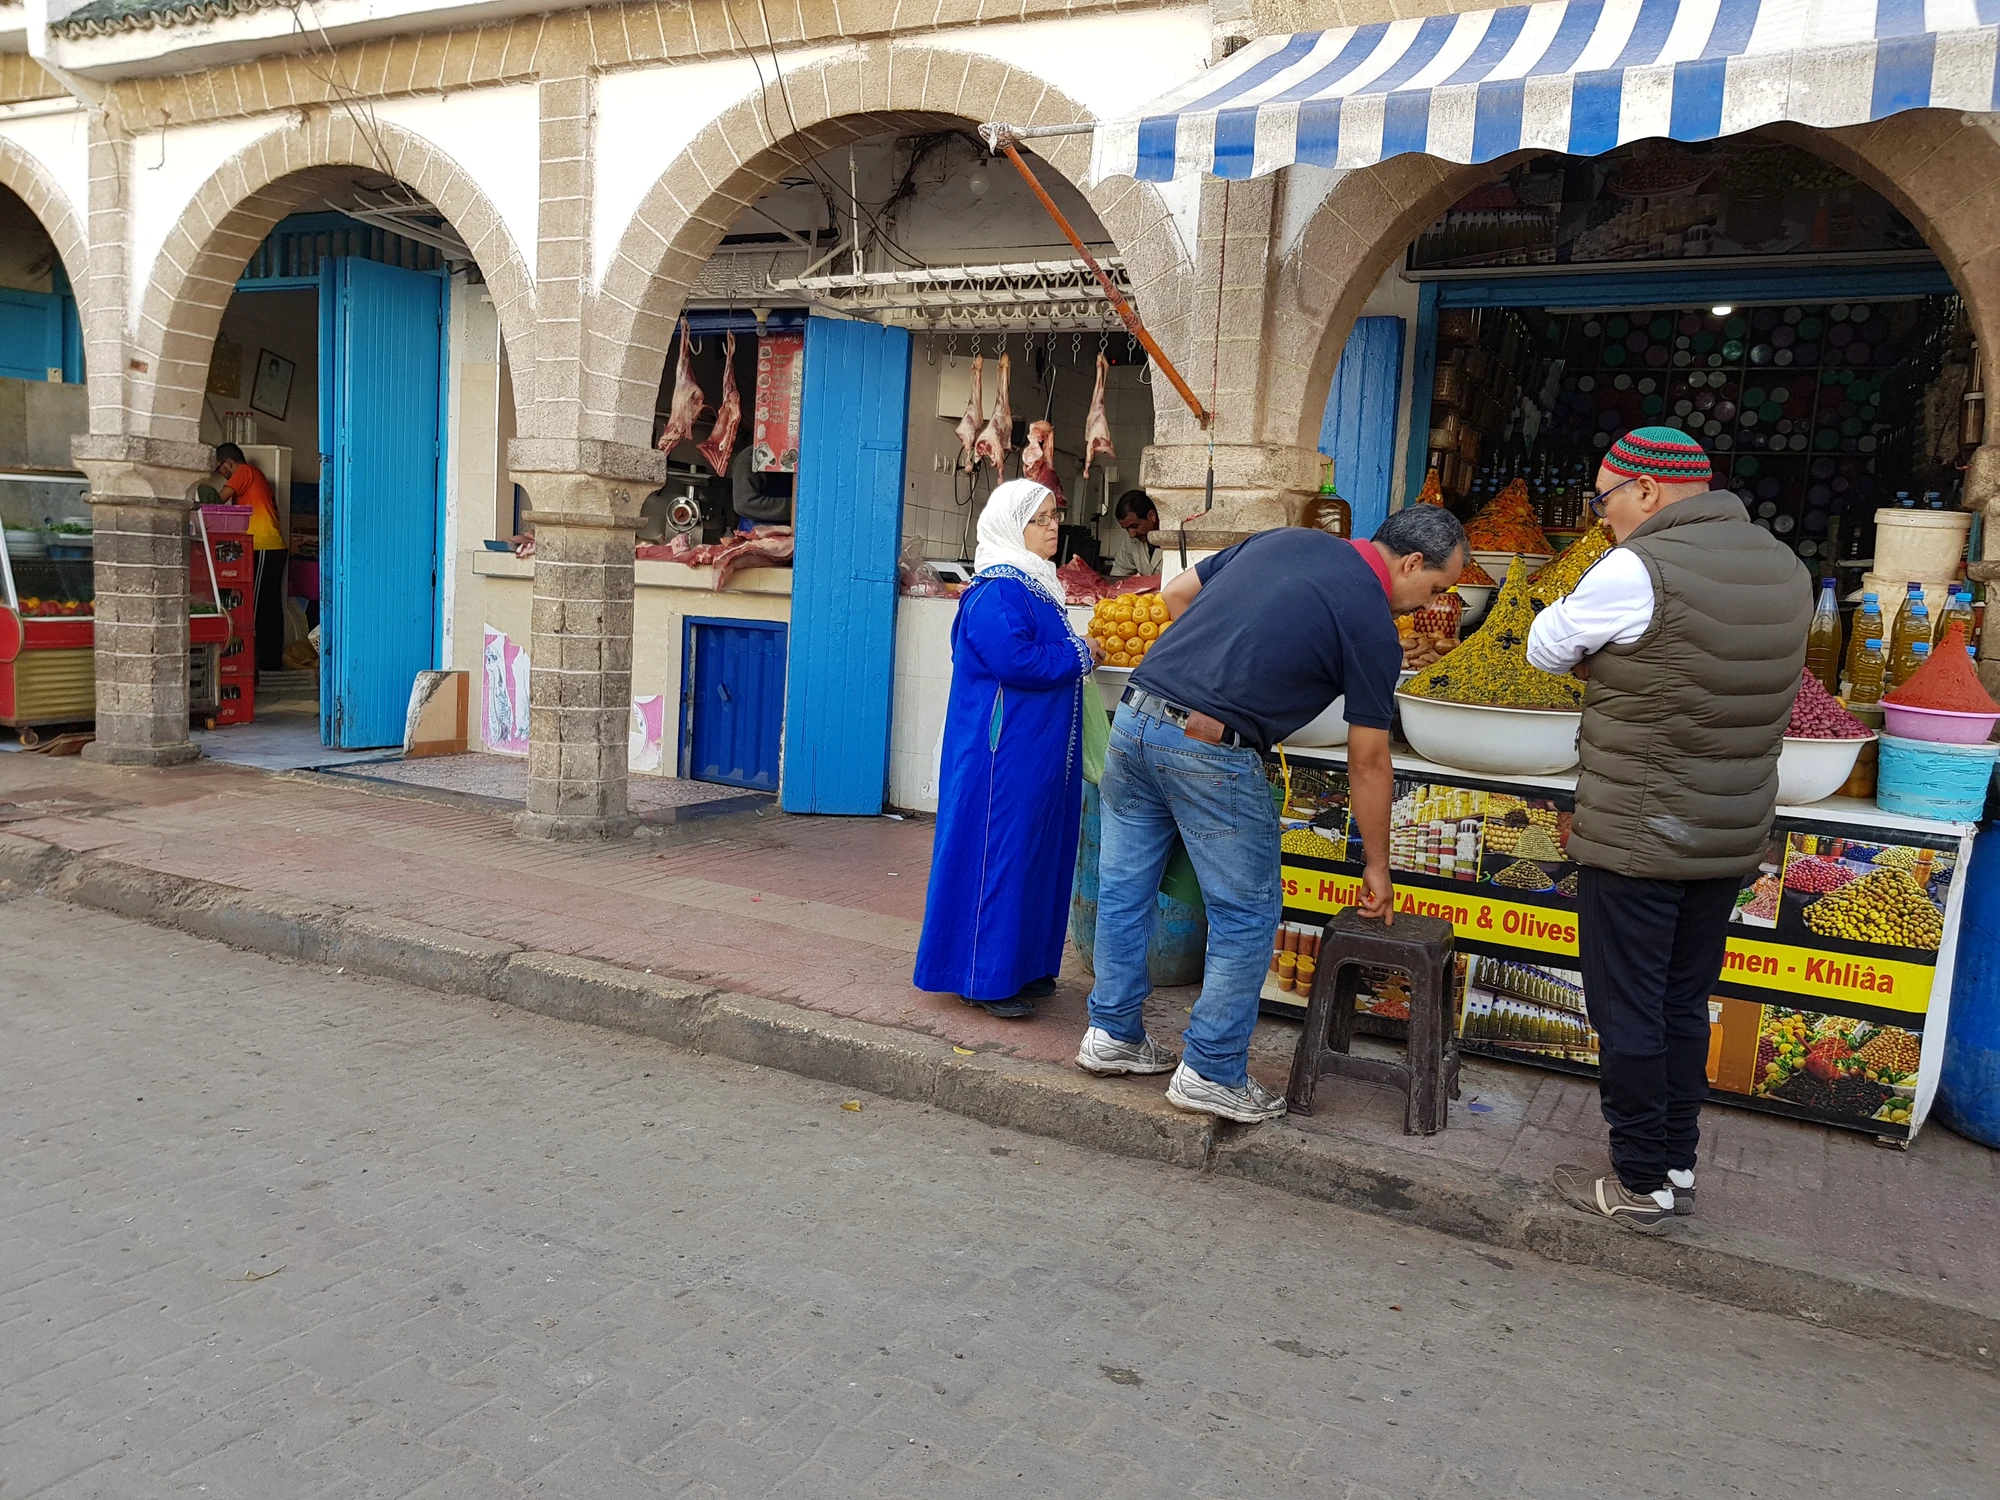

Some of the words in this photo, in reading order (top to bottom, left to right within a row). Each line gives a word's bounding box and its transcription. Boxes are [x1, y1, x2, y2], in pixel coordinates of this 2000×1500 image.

[1475, 903, 1494, 931] &
[1502, 910, 1577, 944] Olives
[1723, 951, 1778, 975] men
[1804, 957, 1893, 994] Khliâa
